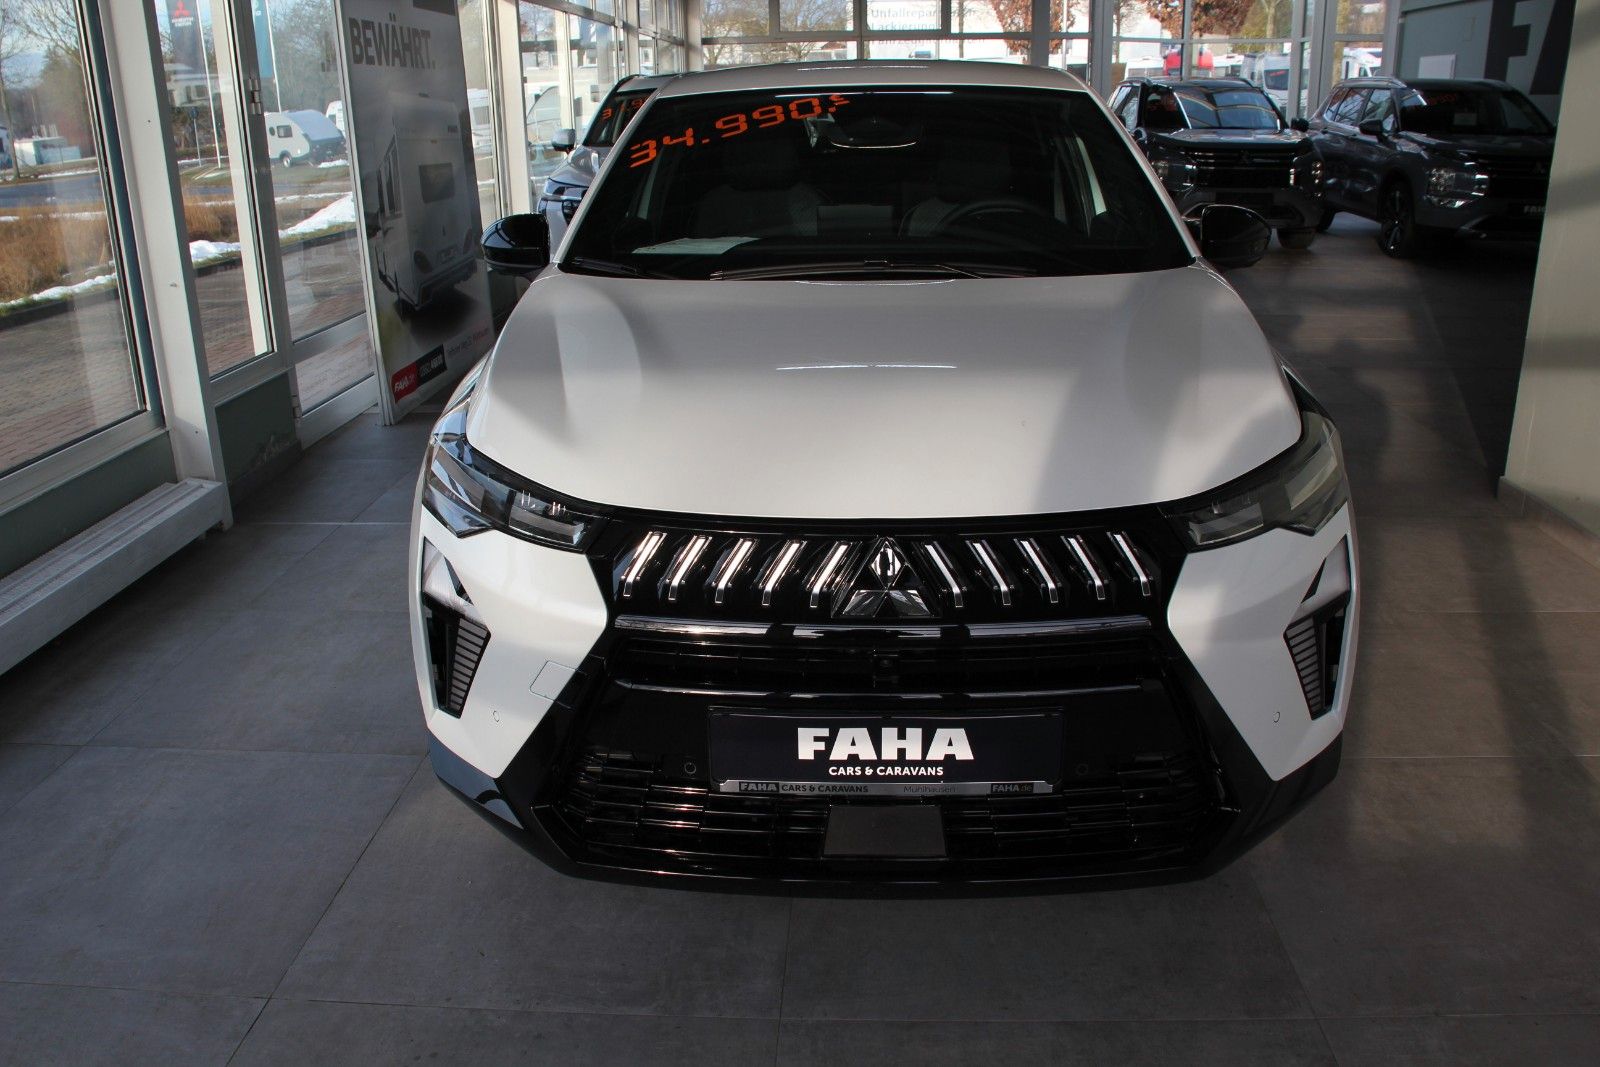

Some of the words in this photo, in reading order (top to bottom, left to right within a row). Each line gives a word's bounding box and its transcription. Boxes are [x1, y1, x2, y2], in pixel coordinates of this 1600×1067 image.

[348, 12, 436, 70] BEWÄHRT.
[797, 727, 974, 760] FAHA
[828, 766, 862, 776] CARS
[865, 766, 874, 776] &
[876, 766, 944, 776] CARAVANS
[740, 783, 777, 792] FAHA
[781, 784, 807, 792] CARS
[818, 785, 869, 793] CARAVANS
